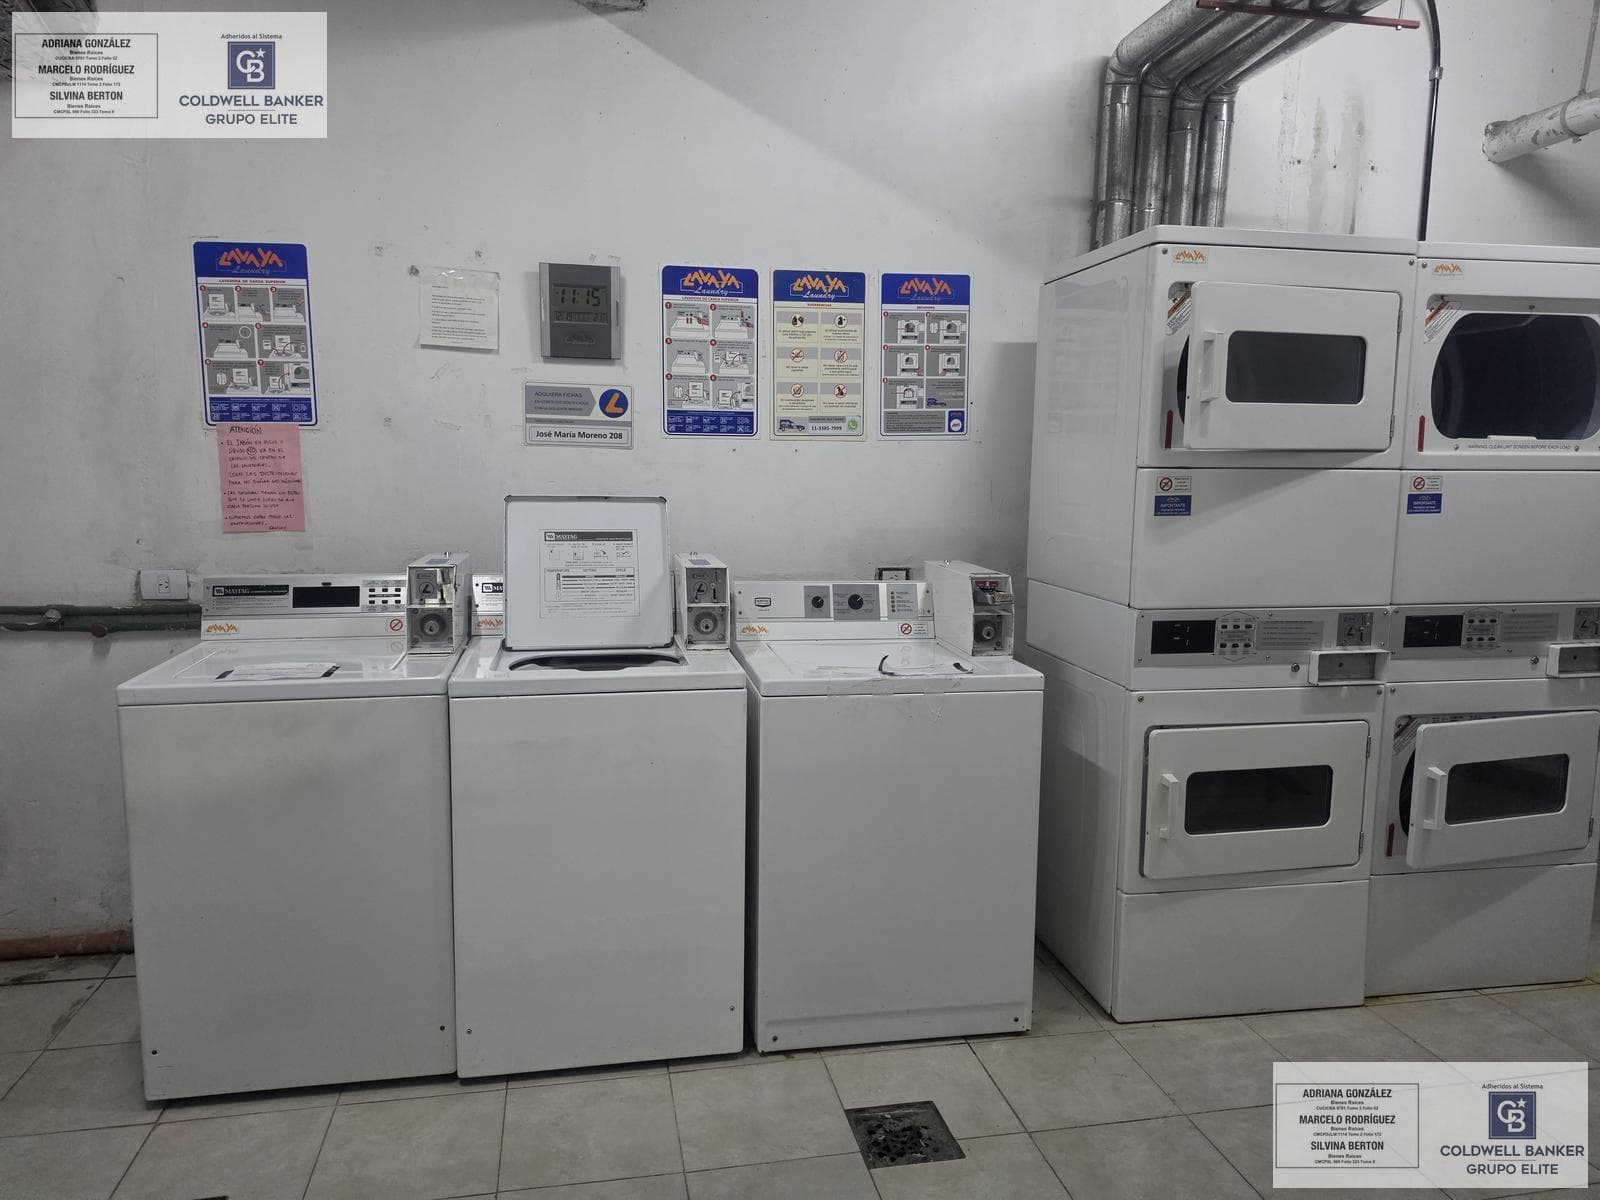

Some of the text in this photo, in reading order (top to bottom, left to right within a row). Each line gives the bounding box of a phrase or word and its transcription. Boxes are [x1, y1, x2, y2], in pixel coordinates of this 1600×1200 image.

[694, 286, 728, 296] Laundry
[803, 290, 836, 301] Laundry
[229, 425, 262, 434] ATENCIÓN
